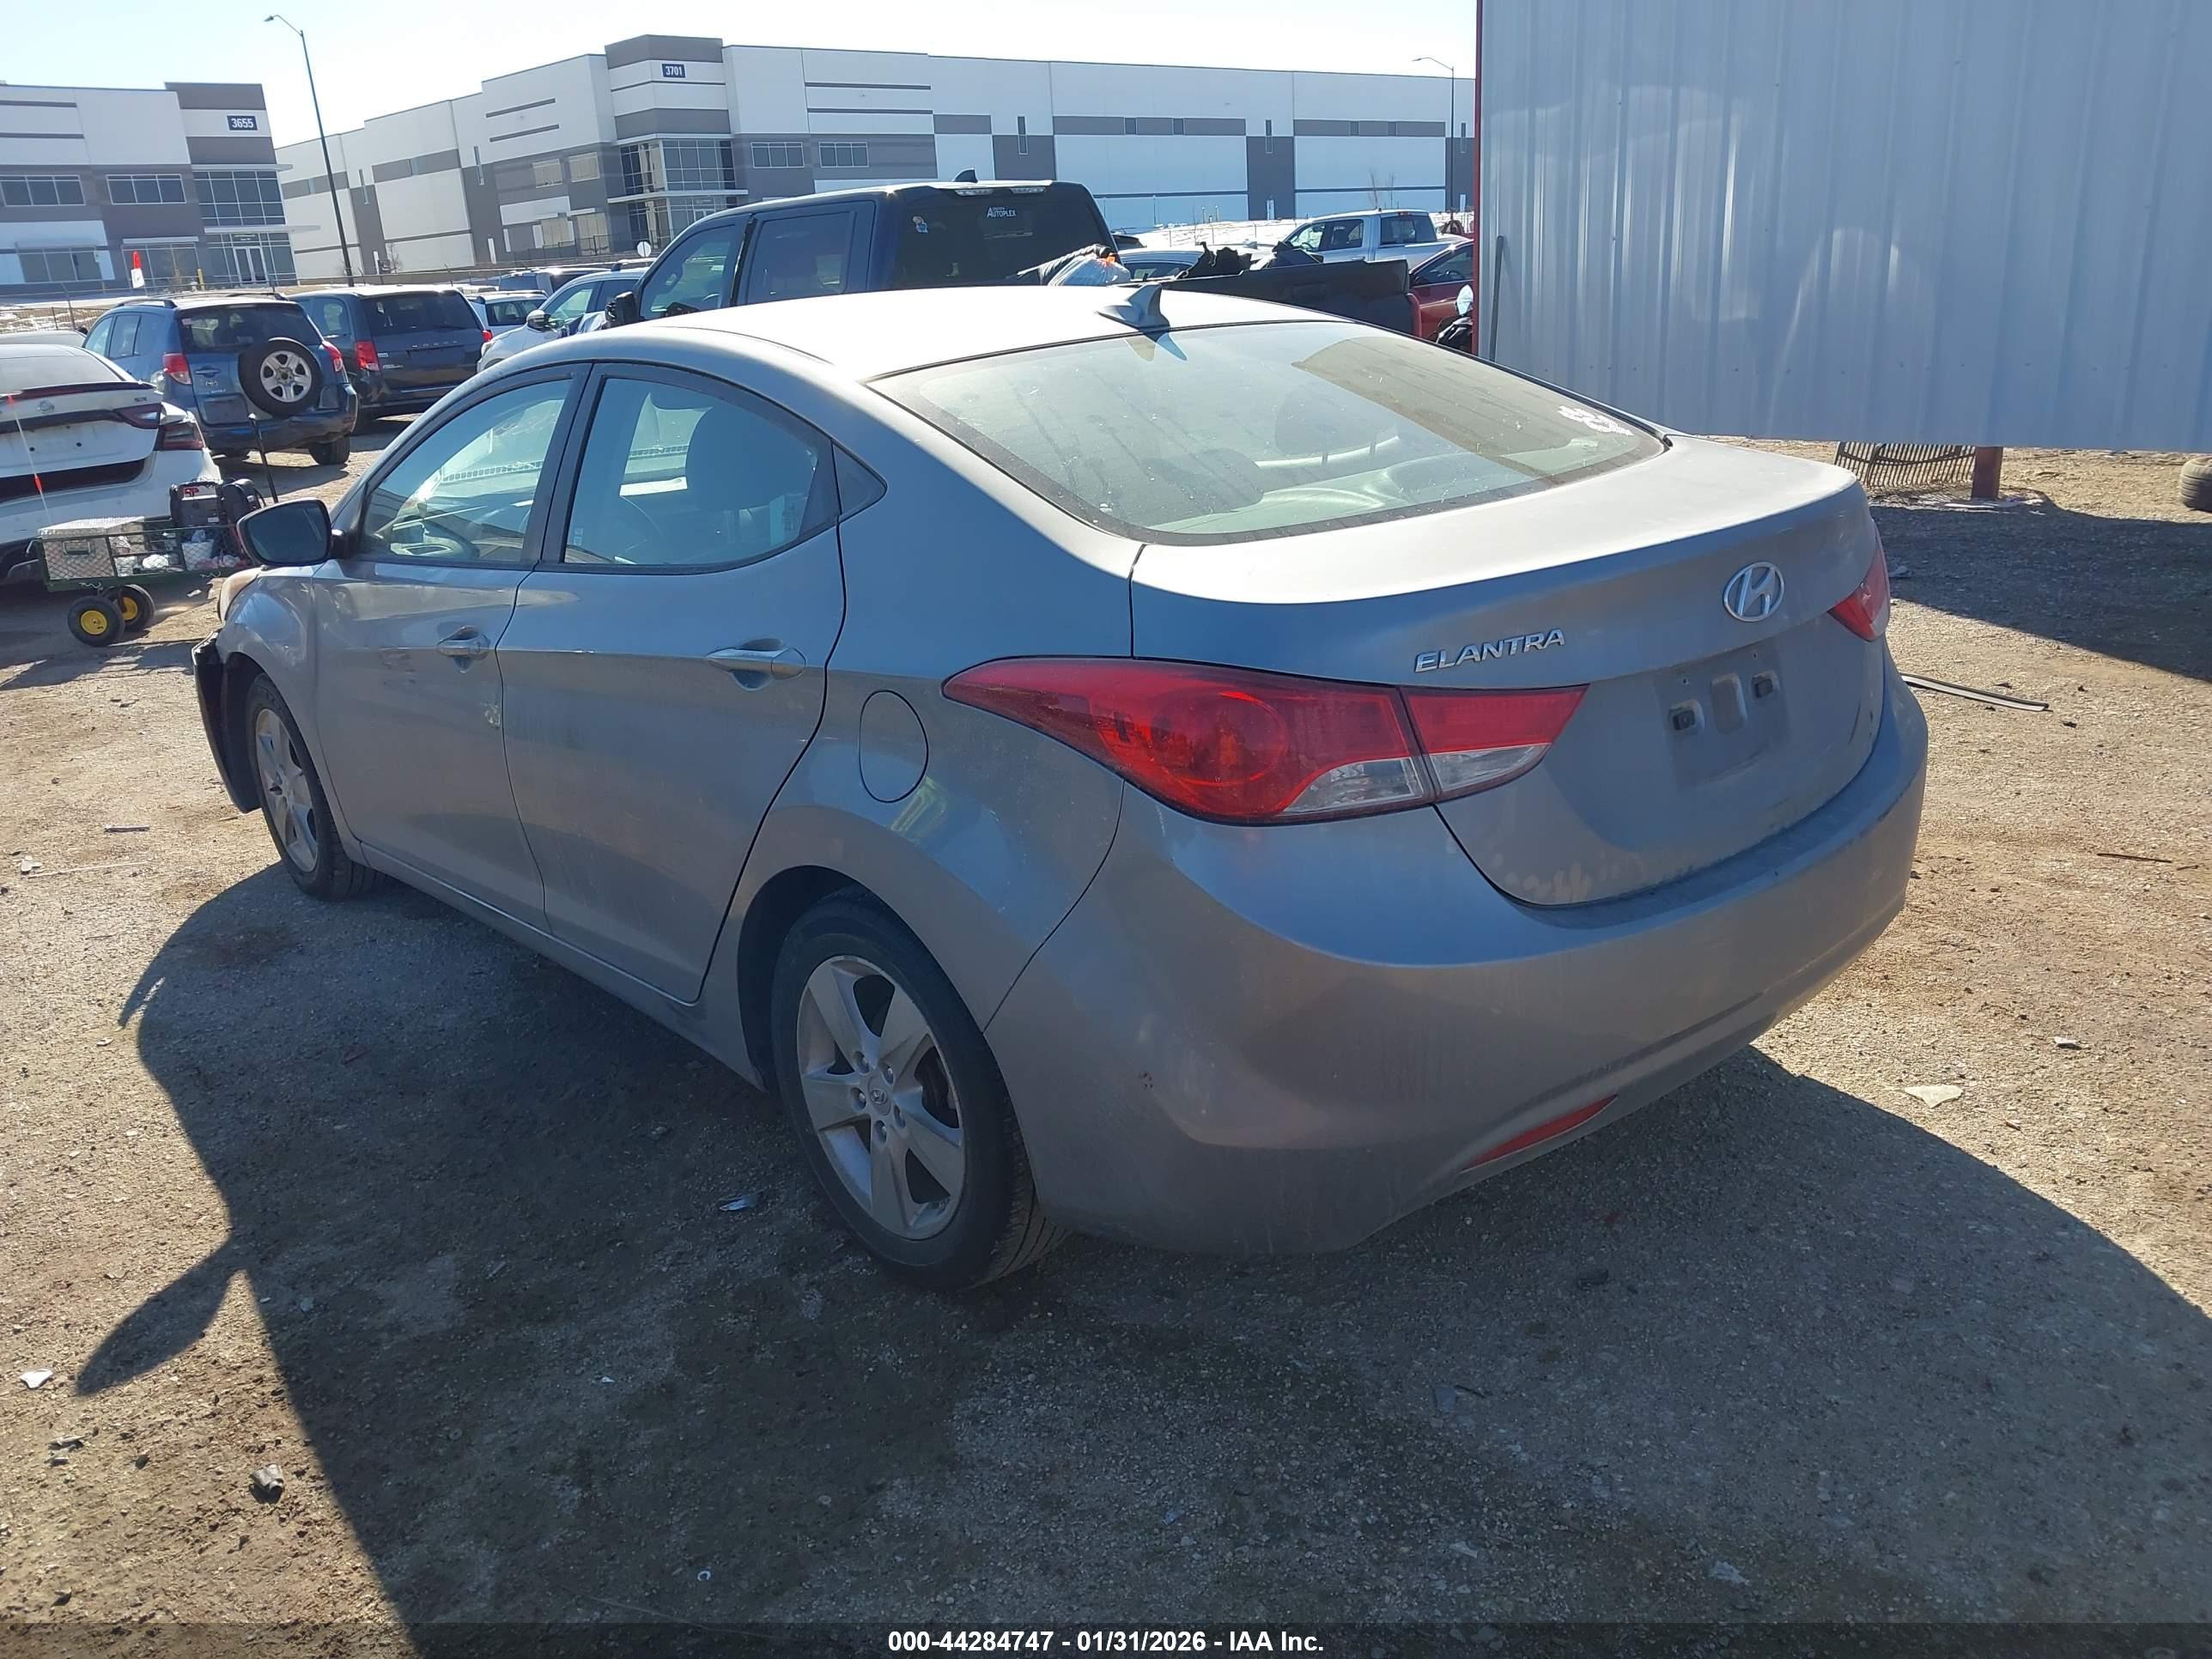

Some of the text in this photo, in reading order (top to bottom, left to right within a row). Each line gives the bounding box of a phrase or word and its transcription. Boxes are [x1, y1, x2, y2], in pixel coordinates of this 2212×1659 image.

[665, 65, 683, 76] 3701
[231, 118, 254, 129] 3655
[1414, 628, 1565, 673] ELANTRA
